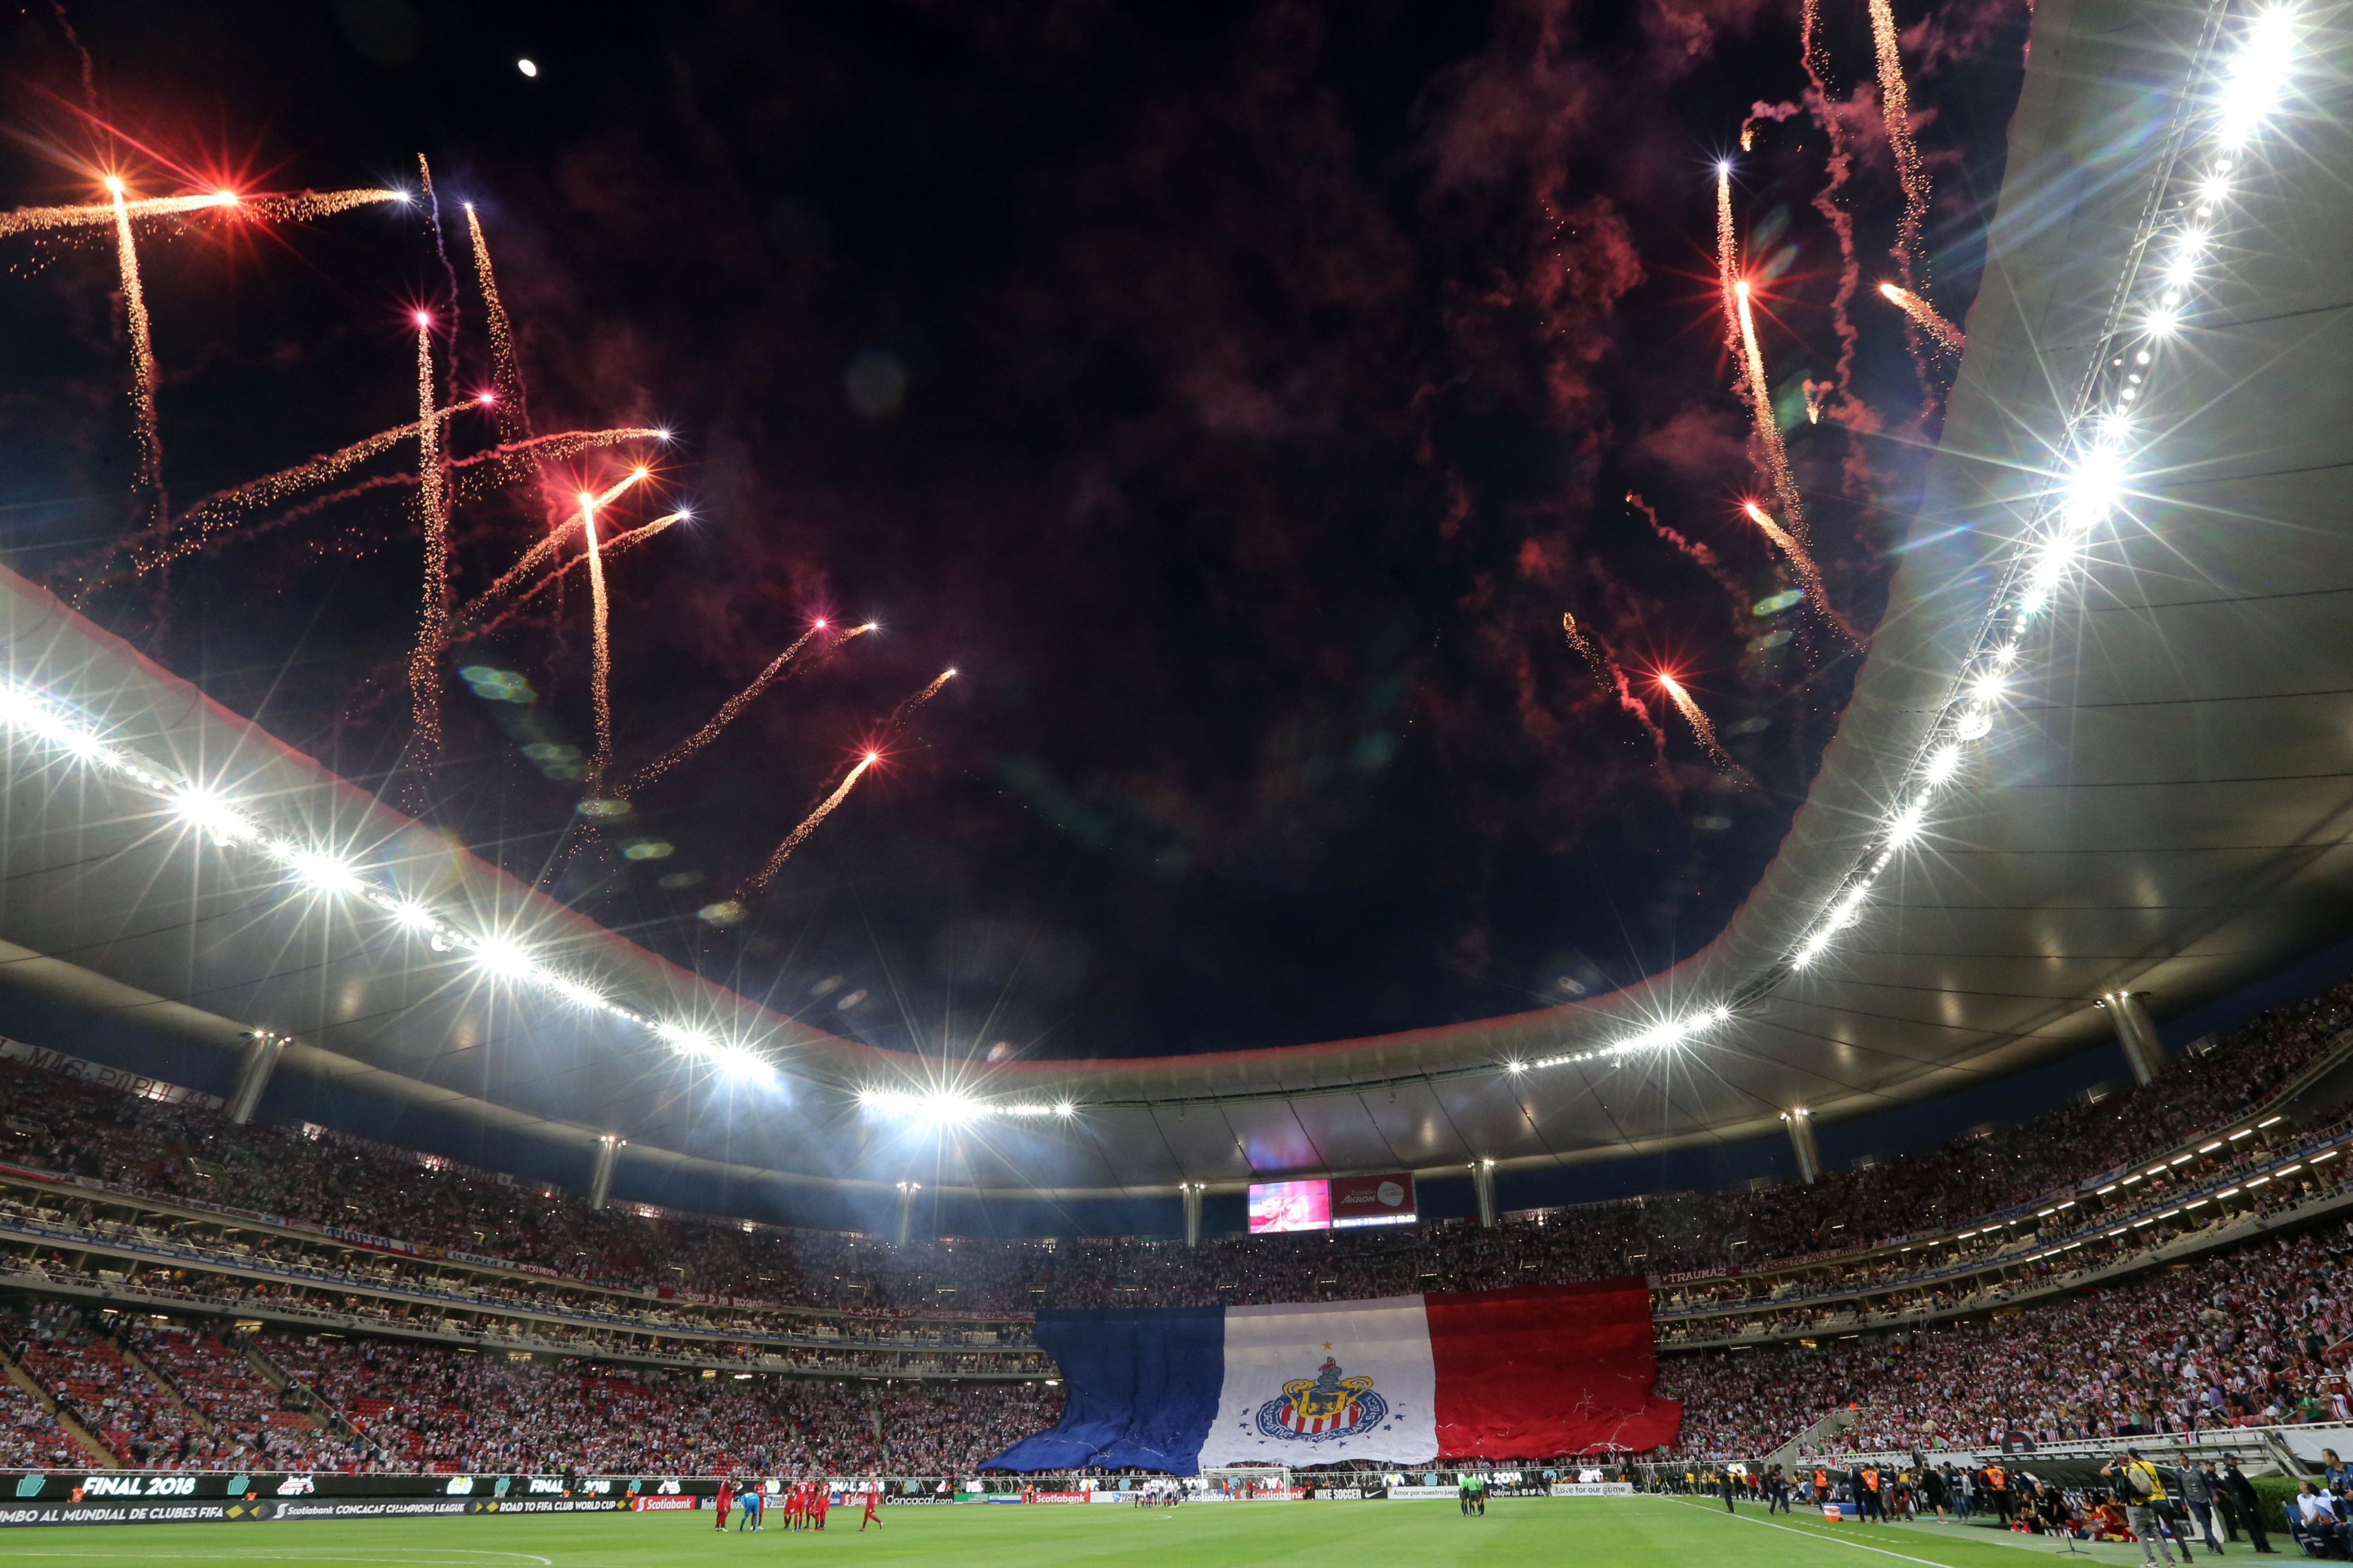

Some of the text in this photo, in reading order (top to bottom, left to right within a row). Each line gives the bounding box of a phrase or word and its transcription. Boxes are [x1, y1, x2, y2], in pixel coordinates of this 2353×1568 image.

[1341, 1195, 1375, 1204] AKRON
[82, 1477, 196, 1495] FINAL 2018
[530, 1480, 611, 1493] FINAL 2018
[1036, 1493, 1085, 1503] Scotiabank
[1315, 1489, 1361, 1500] NIKE SOCCER
[287, 1503, 465, 1515] Scotiabank CONCACAF CHAMPIONS LEAGUE
[500, 1500, 616, 1512] ROAD TO FIFA CLUB WORLD CUP
[646, 1497, 691, 1510] Scotiabank
[701, 1499, 717, 1509] Model
[39, 1509, 59, 1521] AL
[61, 1508, 126, 1521] MUNDIAL
[129, 1508, 147, 1519] DE
[149, 1507, 196, 1519] CLUBES
[198, 1506, 223, 1518] FIFA
